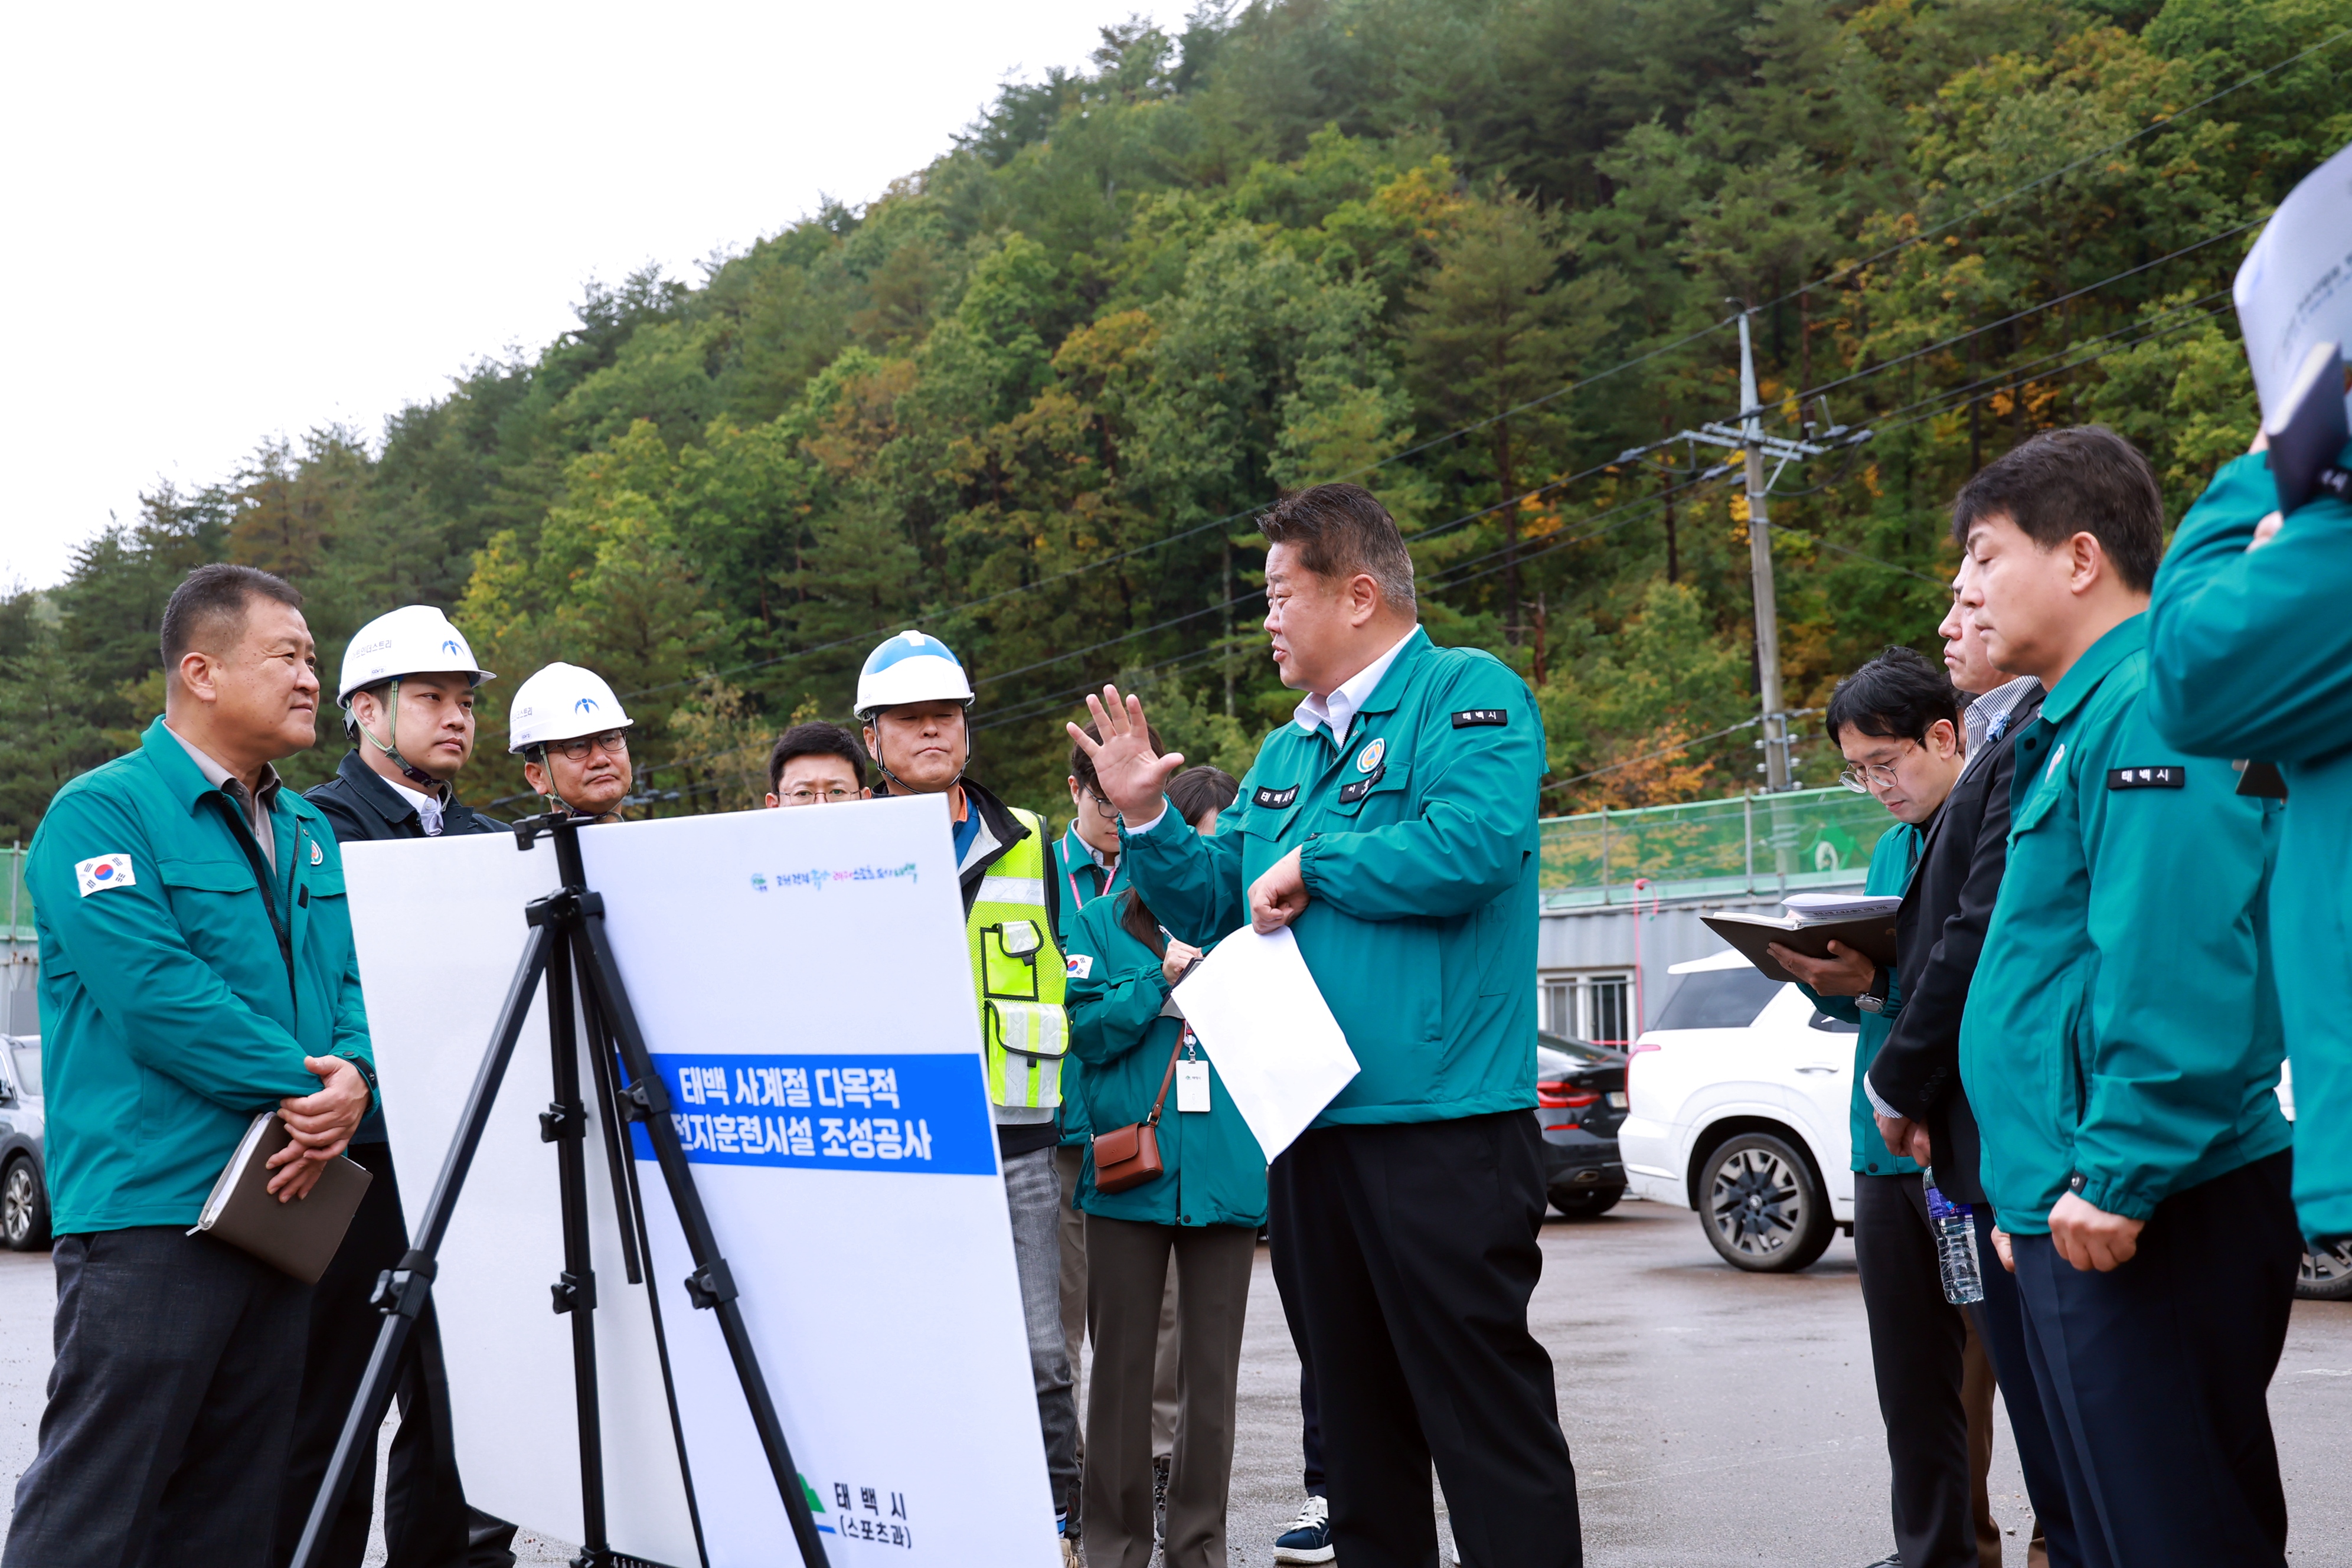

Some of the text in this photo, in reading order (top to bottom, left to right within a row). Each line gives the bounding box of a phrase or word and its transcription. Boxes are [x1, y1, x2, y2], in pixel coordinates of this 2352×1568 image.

[1462, 711, 1497, 720] 태백시
[2121, 769, 2168, 782] 태백시
[678, 1066, 900, 1109] 태백 사계절 다목적
[671, 1113, 932, 1161] 전지훈련시설 조성공사
[834, 1482, 907, 1521] 태백시
[840, 1514, 912, 1550] (스포츠과)
